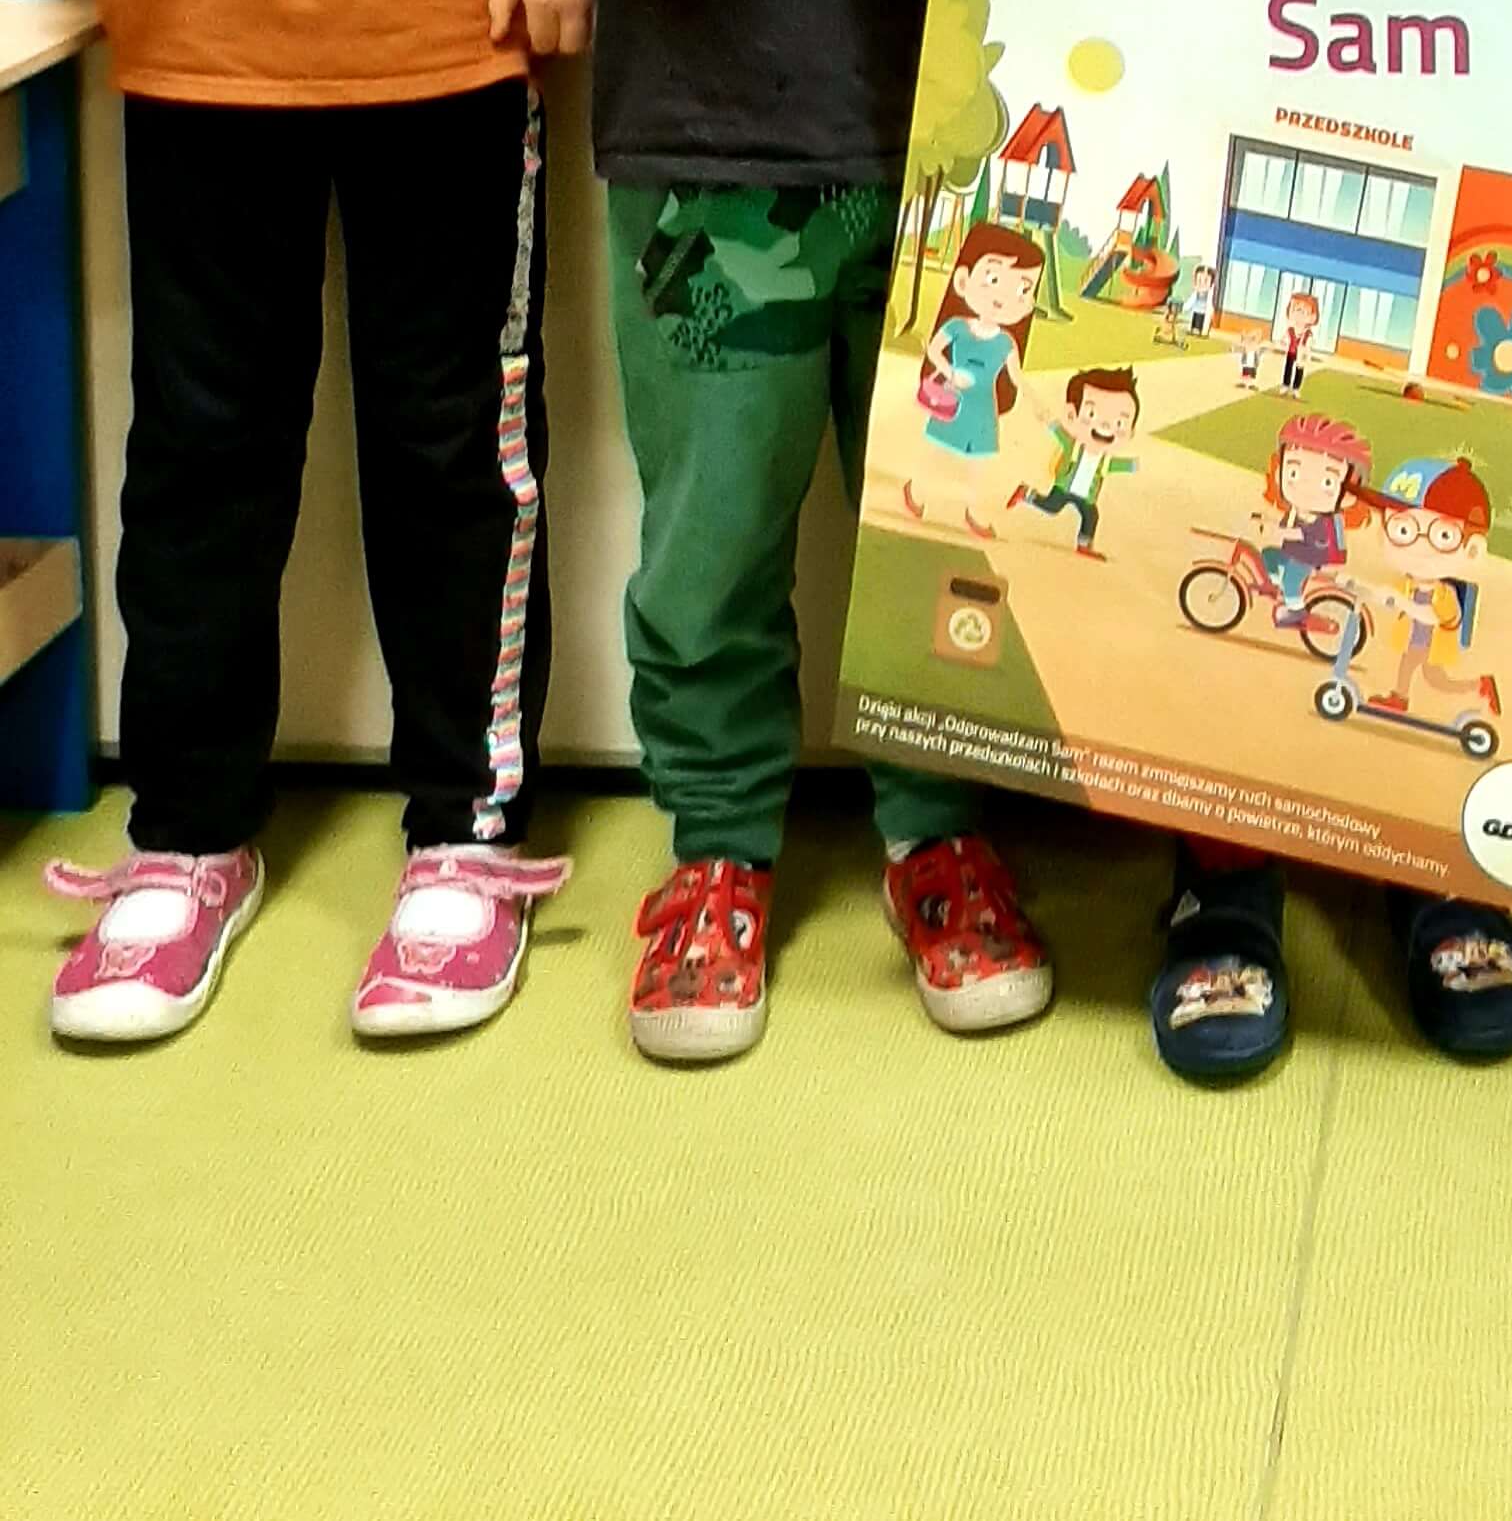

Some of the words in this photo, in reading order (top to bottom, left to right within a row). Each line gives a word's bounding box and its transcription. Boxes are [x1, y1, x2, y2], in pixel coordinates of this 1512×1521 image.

[1275, 106, 1415, 152] PRZEDSZKOLE
[855, 717, 888, 743] przy
[889, 725, 947, 752] naszych
[949, 738, 1051, 777] przedszkolach
[1061, 764, 1126, 794] szkołach
[1127, 781, 1160, 803] oraz
[1162, 787, 1213, 817] dbamy
[1214, 802, 1225, 819] o
[1226, 805, 1305, 840] powietrze,
[1307, 823, 1361, 855] którym
[1362, 839, 1451, 879] oddychamy.
[858, 693, 901, 721] Dzięki
[903, 704, 937, 729] akcji
[1092, 751, 1139, 777] razem
[1141, 766, 1238, 803] zmniejszamy
[1239, 788, 1272, 810] ruch
[1274, 796, 1383, 840] samochodowy
